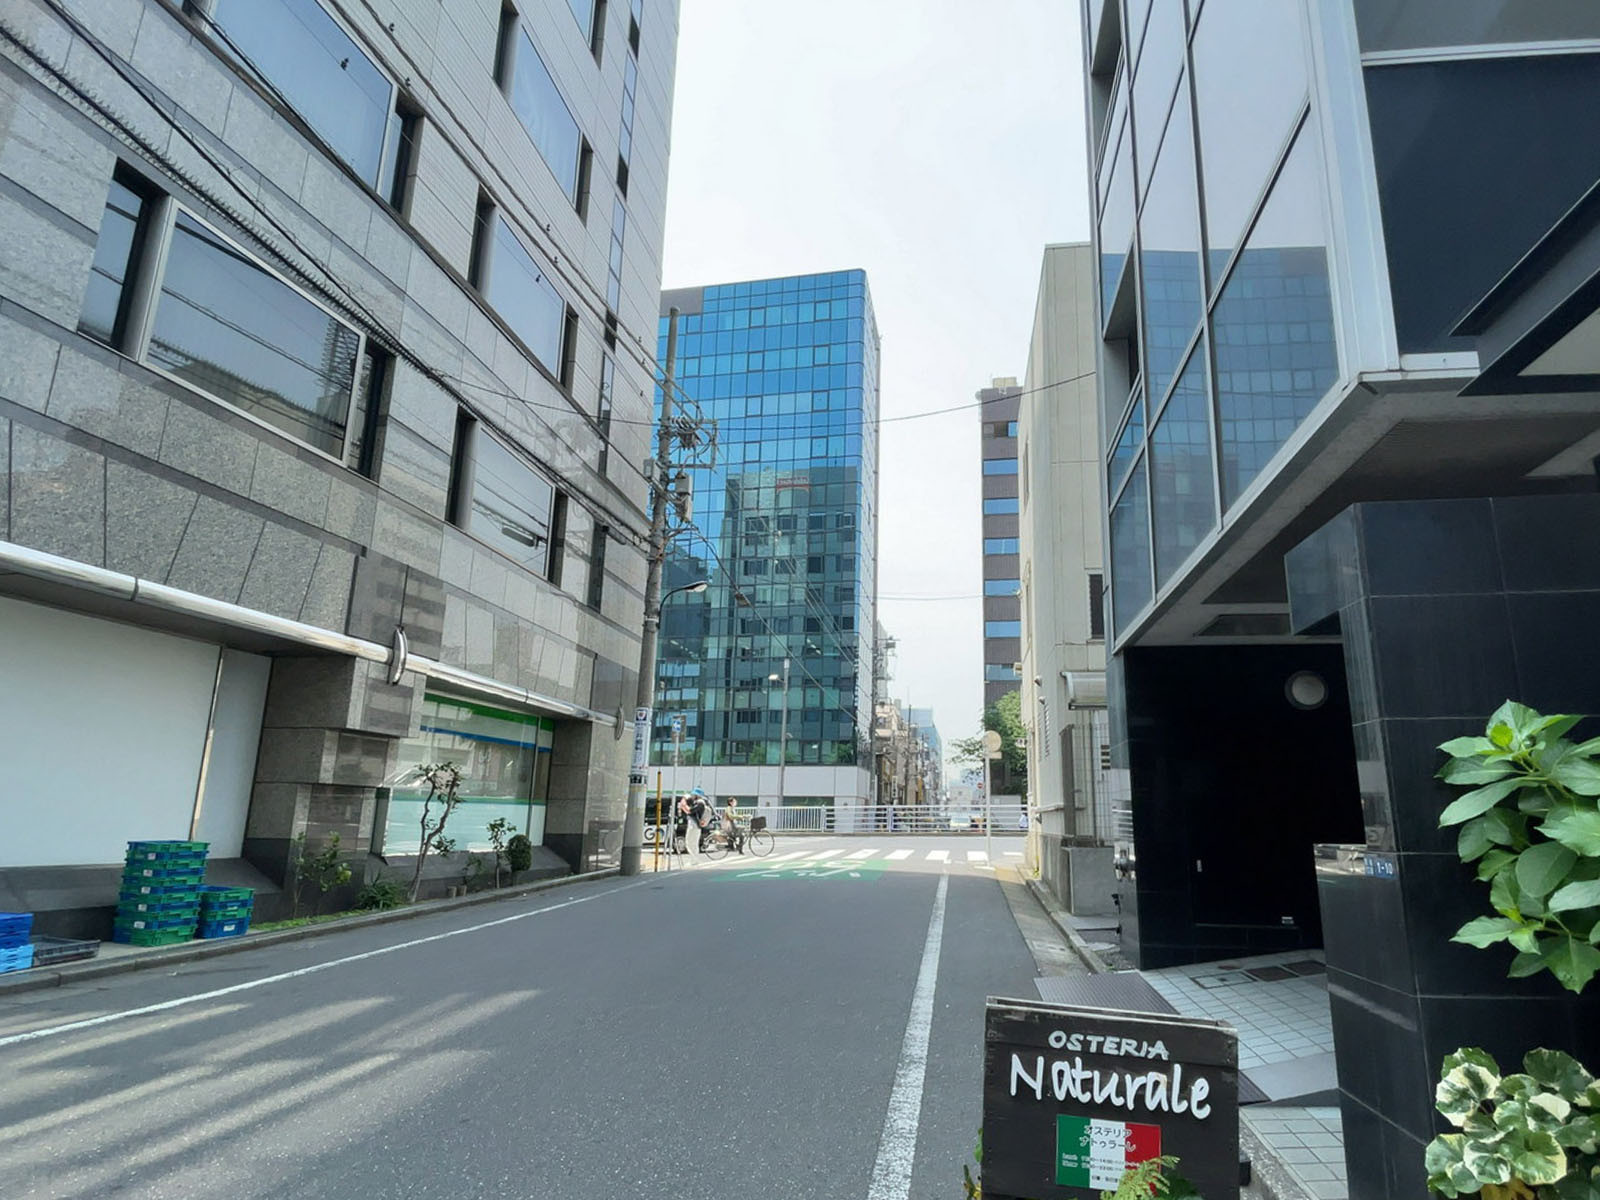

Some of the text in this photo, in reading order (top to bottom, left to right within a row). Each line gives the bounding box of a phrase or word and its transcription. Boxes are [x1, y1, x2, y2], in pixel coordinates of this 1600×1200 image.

[1048, 1030, 1170, 1061] OSTERIA
[1010, 1053, 1211, 1119] Naturale
[1083, 1124, 1133, 1138] オステリア
